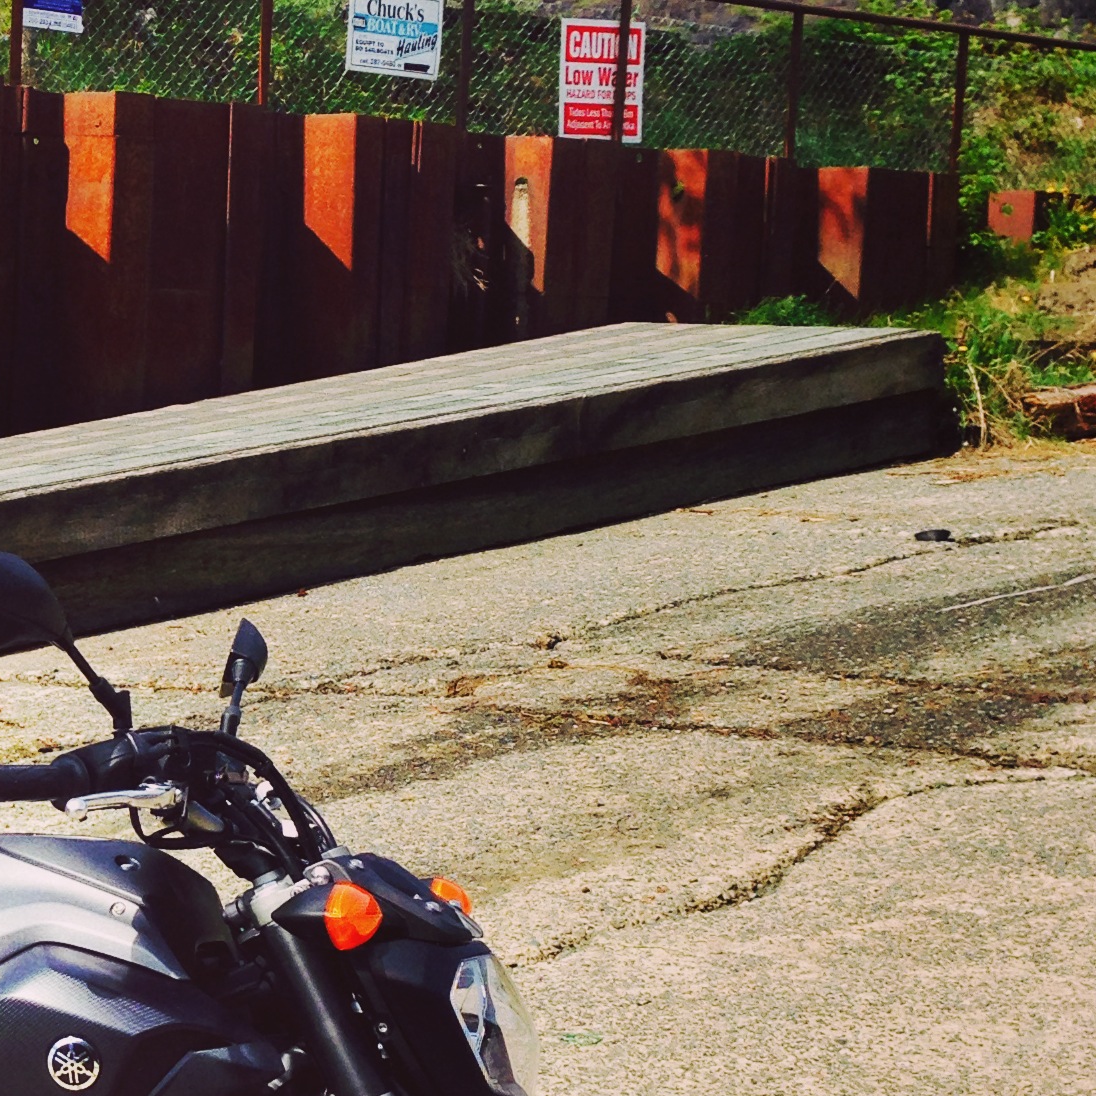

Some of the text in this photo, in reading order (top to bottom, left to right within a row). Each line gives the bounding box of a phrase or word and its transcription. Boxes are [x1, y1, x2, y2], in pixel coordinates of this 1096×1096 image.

[367, 0, 424, 23] Chuck's
[397, 34, 438, 57] Hauling
[565, 66, 639, 88] Low Waer
[566, 90, 595, 99] HAZARD
[598, 90, 612, 100] FOR
[586, 107, 600, 118] Less
[595, 119, 602, 129] To
